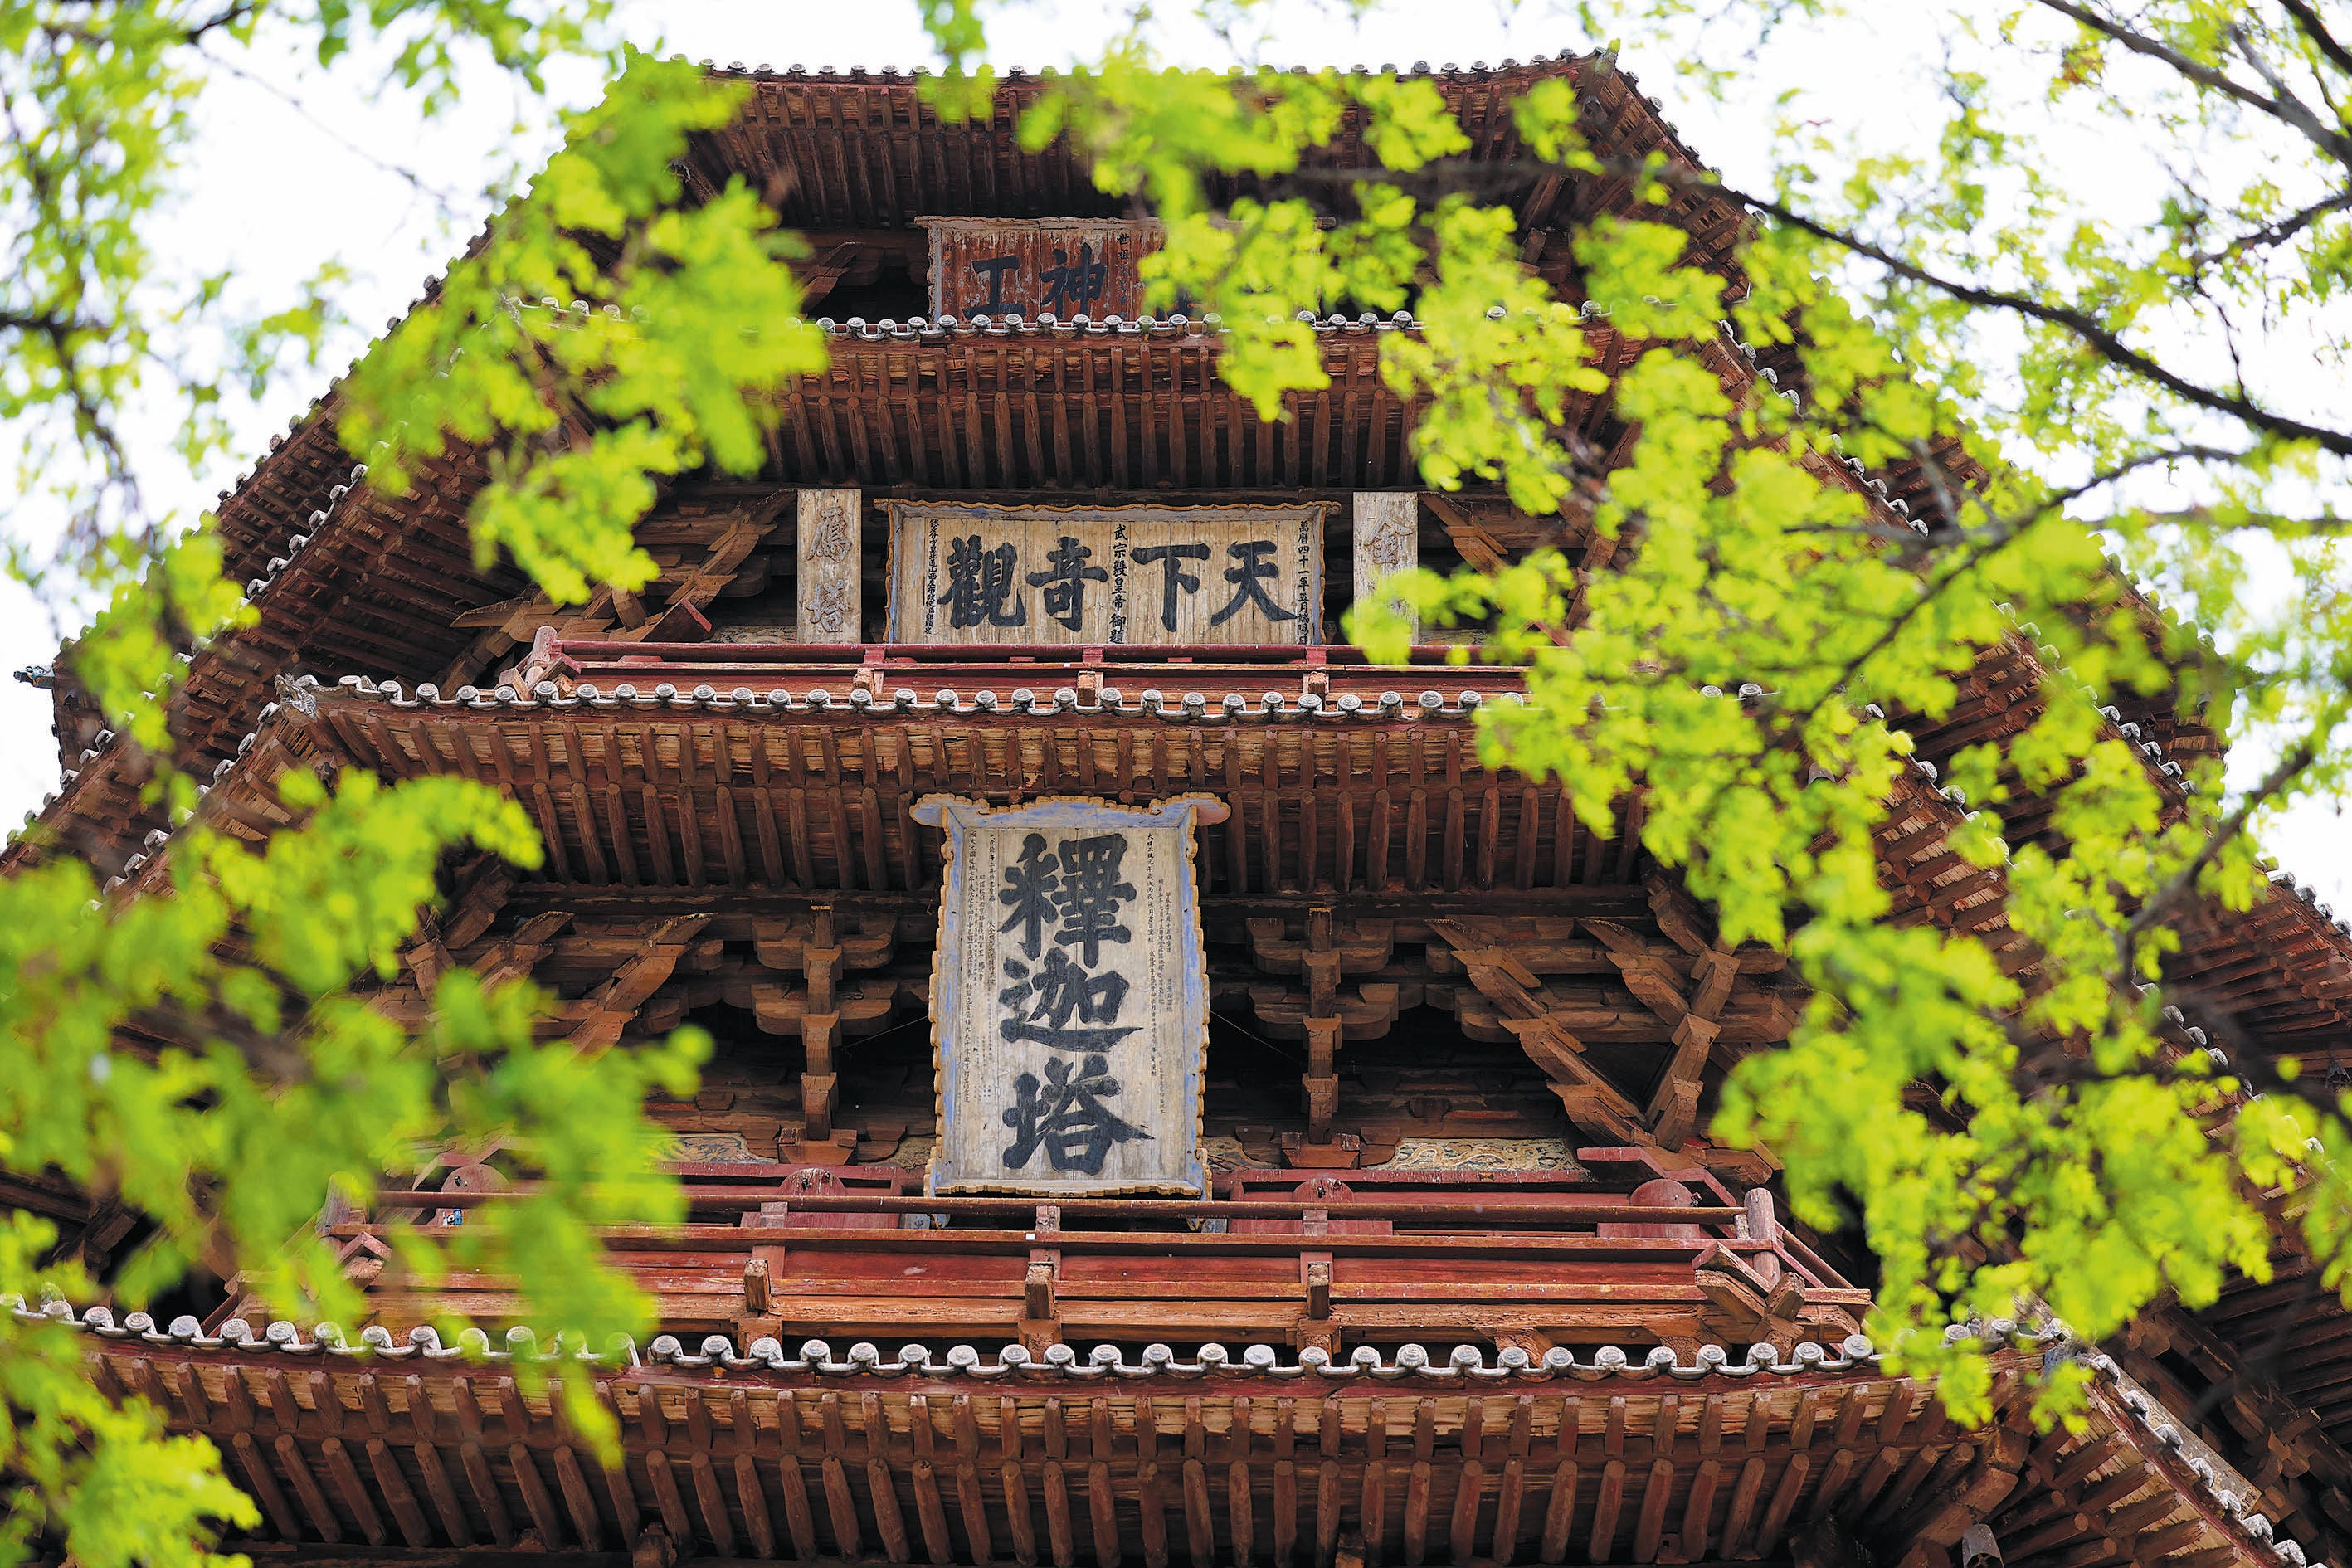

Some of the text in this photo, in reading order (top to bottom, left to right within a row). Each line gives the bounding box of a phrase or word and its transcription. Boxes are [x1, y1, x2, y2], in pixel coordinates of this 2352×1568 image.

[937, 534, 1297, 632] 天下奇觀
[996, 832, 1155, 1176] 釋迦塔
